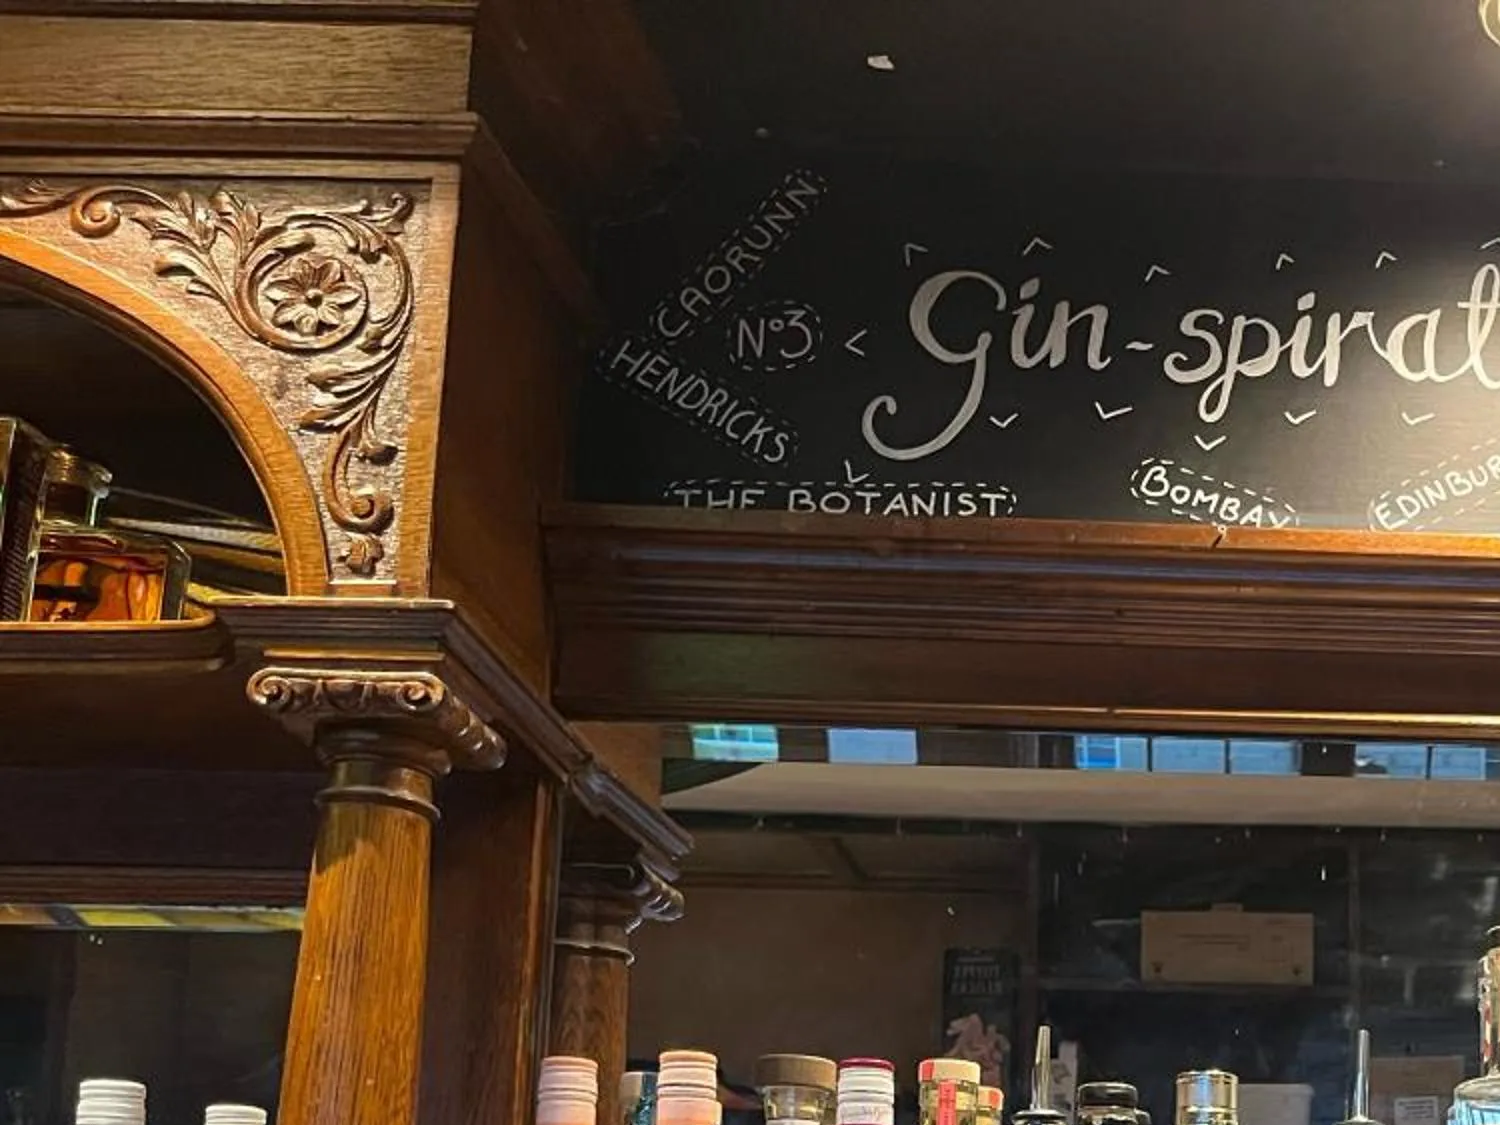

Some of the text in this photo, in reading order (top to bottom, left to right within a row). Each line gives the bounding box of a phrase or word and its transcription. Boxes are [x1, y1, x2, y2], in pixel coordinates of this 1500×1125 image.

[657, 178, 818, 337] CAORUNN
[610, 341, 789, 464] HENDRICKS
[674, 488, 999, 516] THE BOTANIST
[1141, 466, 1290, 528] BOMBAY
